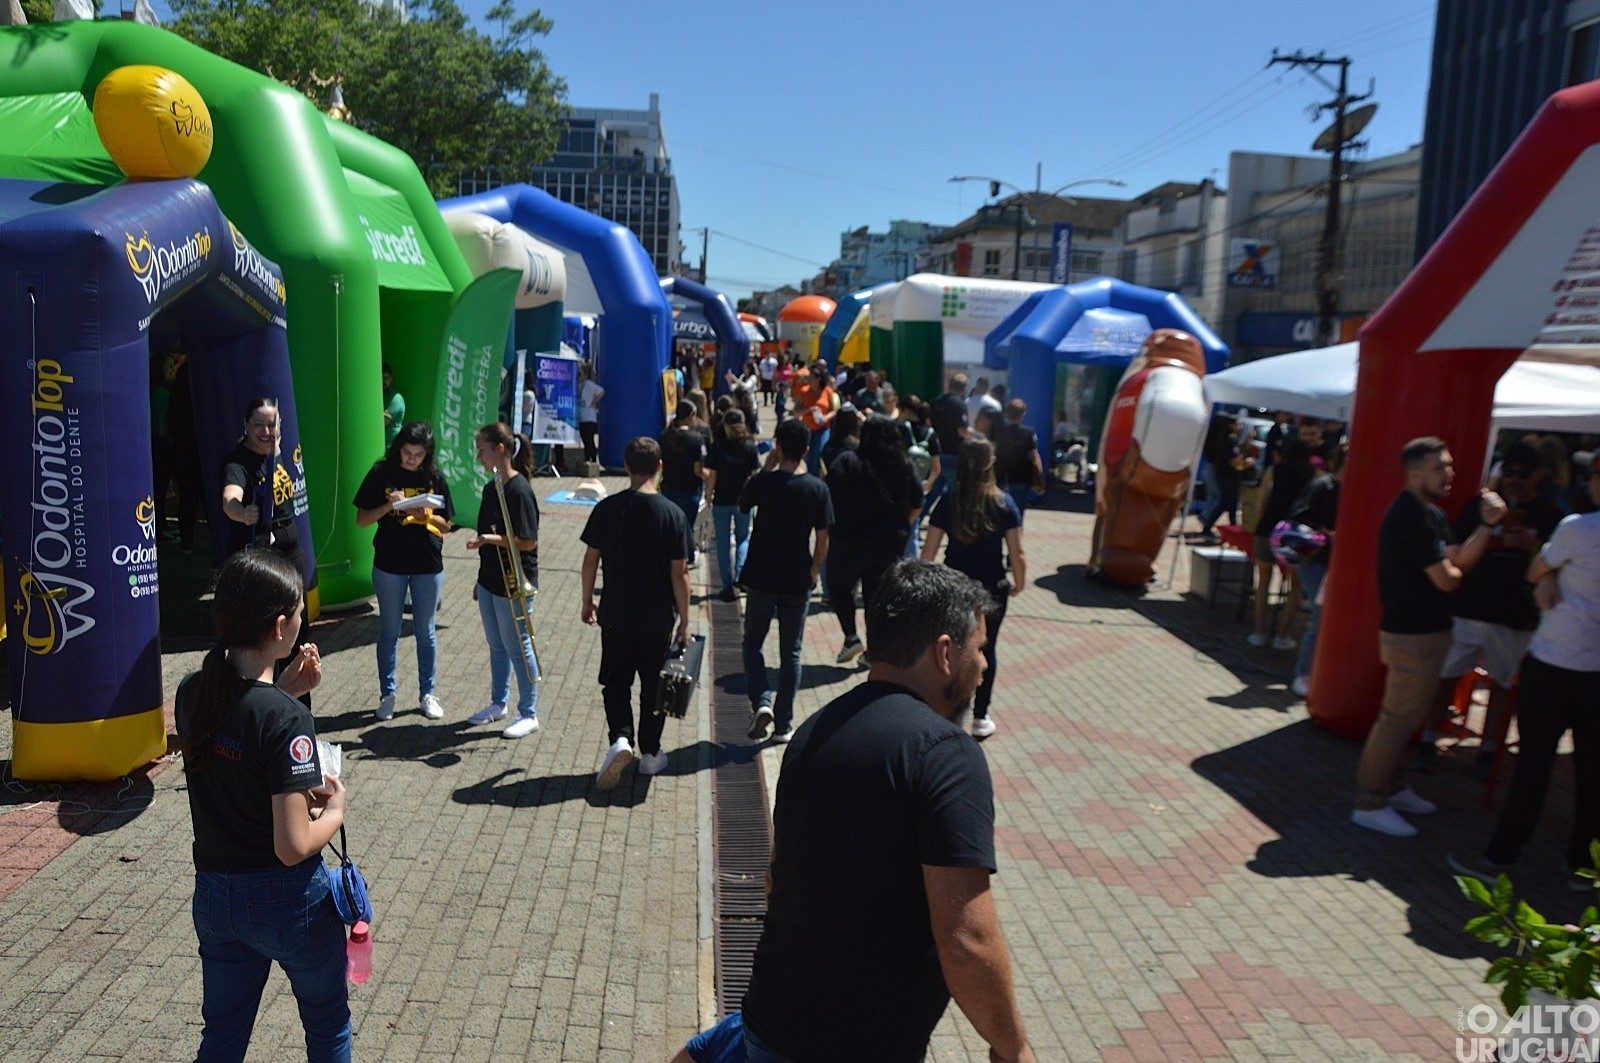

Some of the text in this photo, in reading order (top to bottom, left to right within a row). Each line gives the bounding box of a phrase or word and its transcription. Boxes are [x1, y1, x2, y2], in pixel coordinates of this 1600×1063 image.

[157, 231, 212, 279] OdontoTop
[440, 335, 468, 447] Sicredi
[475, 344, 492, 425] COOPERA
[31, 358, 74, 569] OdontoTop
[67, 407, 87, 568] HOSPITAL DO DENTE
